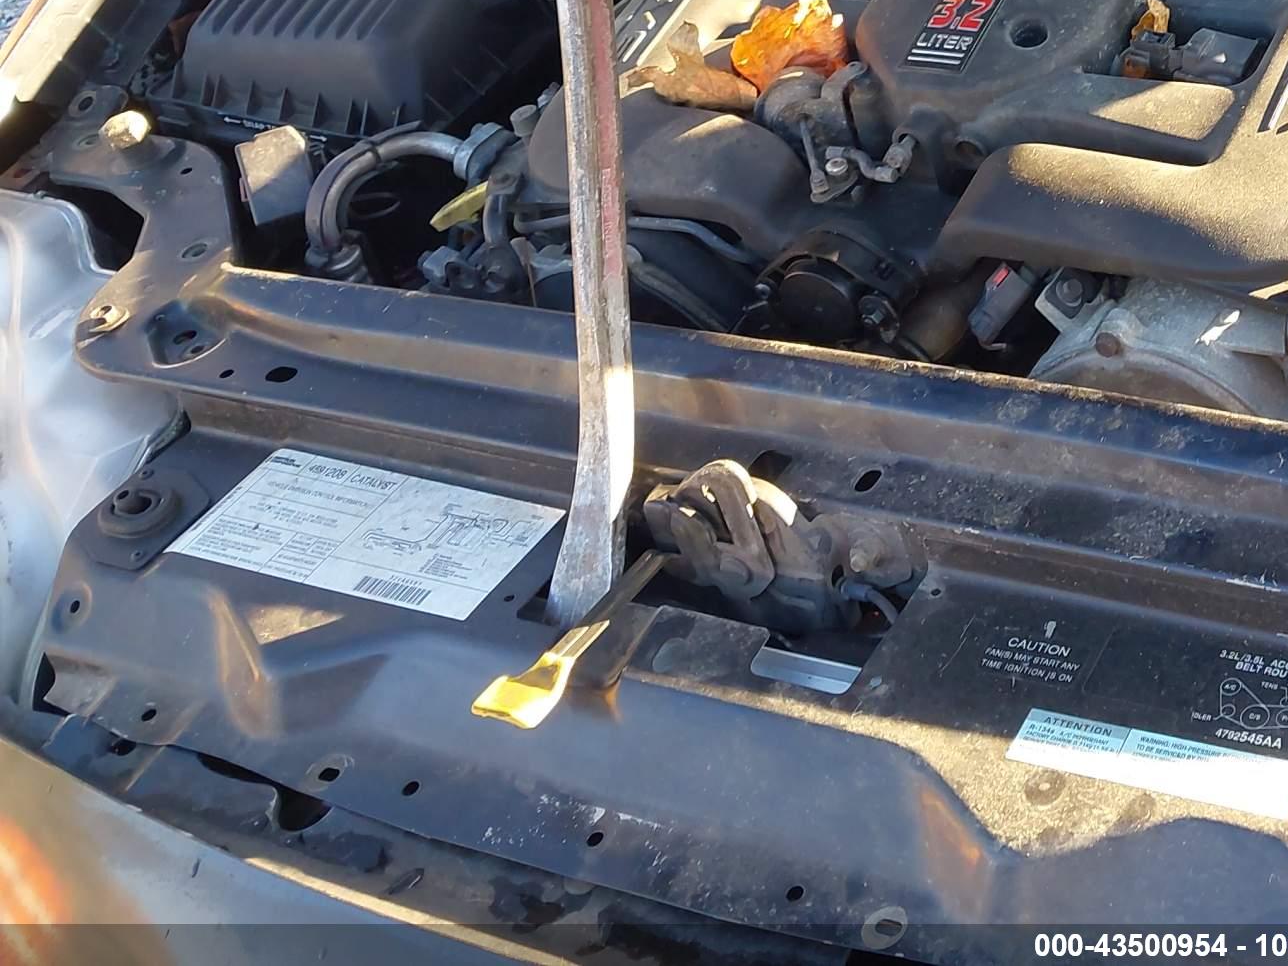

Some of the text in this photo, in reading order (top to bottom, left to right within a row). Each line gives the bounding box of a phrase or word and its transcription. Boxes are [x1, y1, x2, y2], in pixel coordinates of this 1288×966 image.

[916, 32, 973, 51] LITER
[350, 474, 397, 491] CATALYST
[1008, 637, 1071, 657] CAUTION
[984, 647, 1080, 671] FAN(S) MAY START ANY
[1235, 661, 1262, 674] BELT
[981, 658, 1003, 669] TIME
[1004, 663, 1045, 677] IGNITION
[1058, 674, 1073, 682] ON
[1043, 716, 1113, 736] ATTENTION
[1136, 744, 1146, 752] TO
